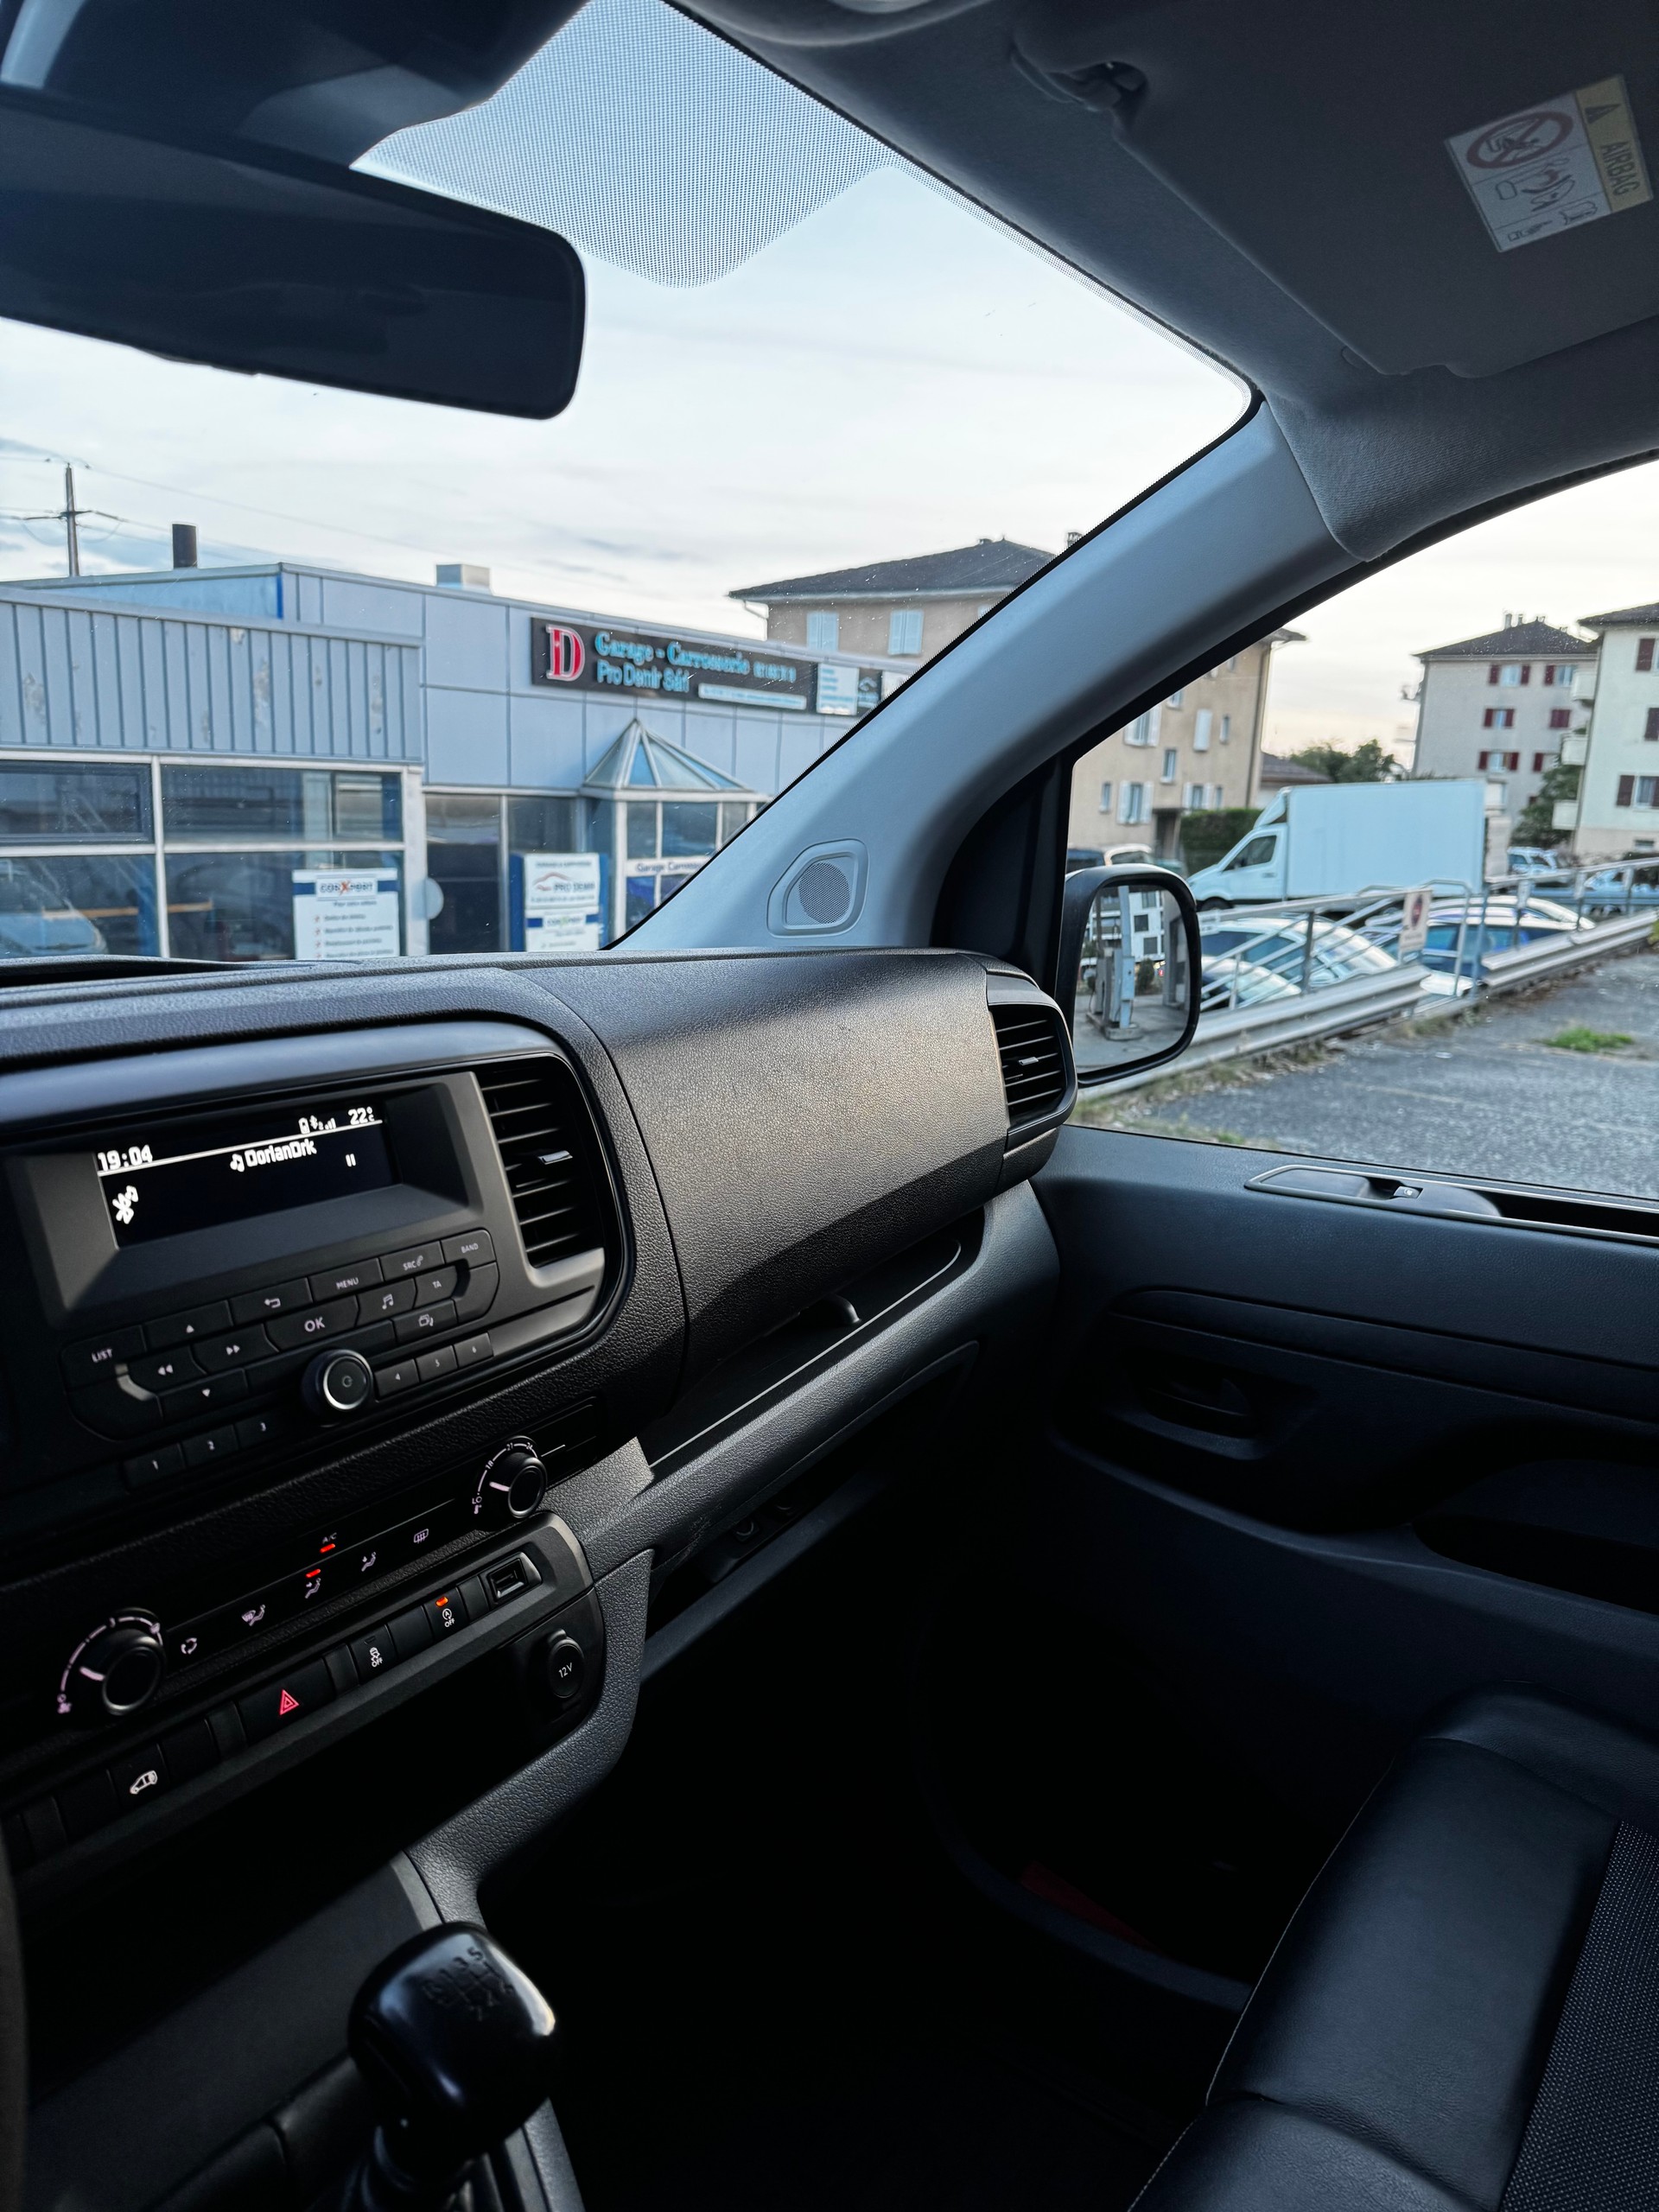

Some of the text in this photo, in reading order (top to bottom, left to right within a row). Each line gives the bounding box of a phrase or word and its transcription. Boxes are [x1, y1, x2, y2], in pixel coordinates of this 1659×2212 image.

[1600, 140, 1640, 196] AIRBAG
[594, 631, 654, 665] Garage
[666, 641, 750, 676] Carrosserie
[597, 658, 623, 686] Pro
[98, 1145, 153, 1172] 19:04
[244, 1139, 317, 1167] DorianDrk
[461, 1243, 479, 1253] BAND
[403, 1260, 417, 1271] SRC
[336, 1277, 359, 1289] MENU
[432, 1280, 442, 1289] TA
[304, 1316, 326, 1332] OK
[91, 1348, 112, 1363] LIST
[435, 1358, 441, 1368] 5
[395, 1371, 401, 1382] 4
[259, 1421, 266, 1432] 3
[207, 1440, 215, 1451] 2
[505, 1442, 514, 1452] 21
[152, 1459, 159, 1471] 1
[485, 1459, 495, 1470] 18
[321, 1532, 337, 1544] A/C
[443, 1618, 455, 1628] OFF
[371, 1656, 384, 1668] OFF
[558, 1662, 572, 1678] 12V
